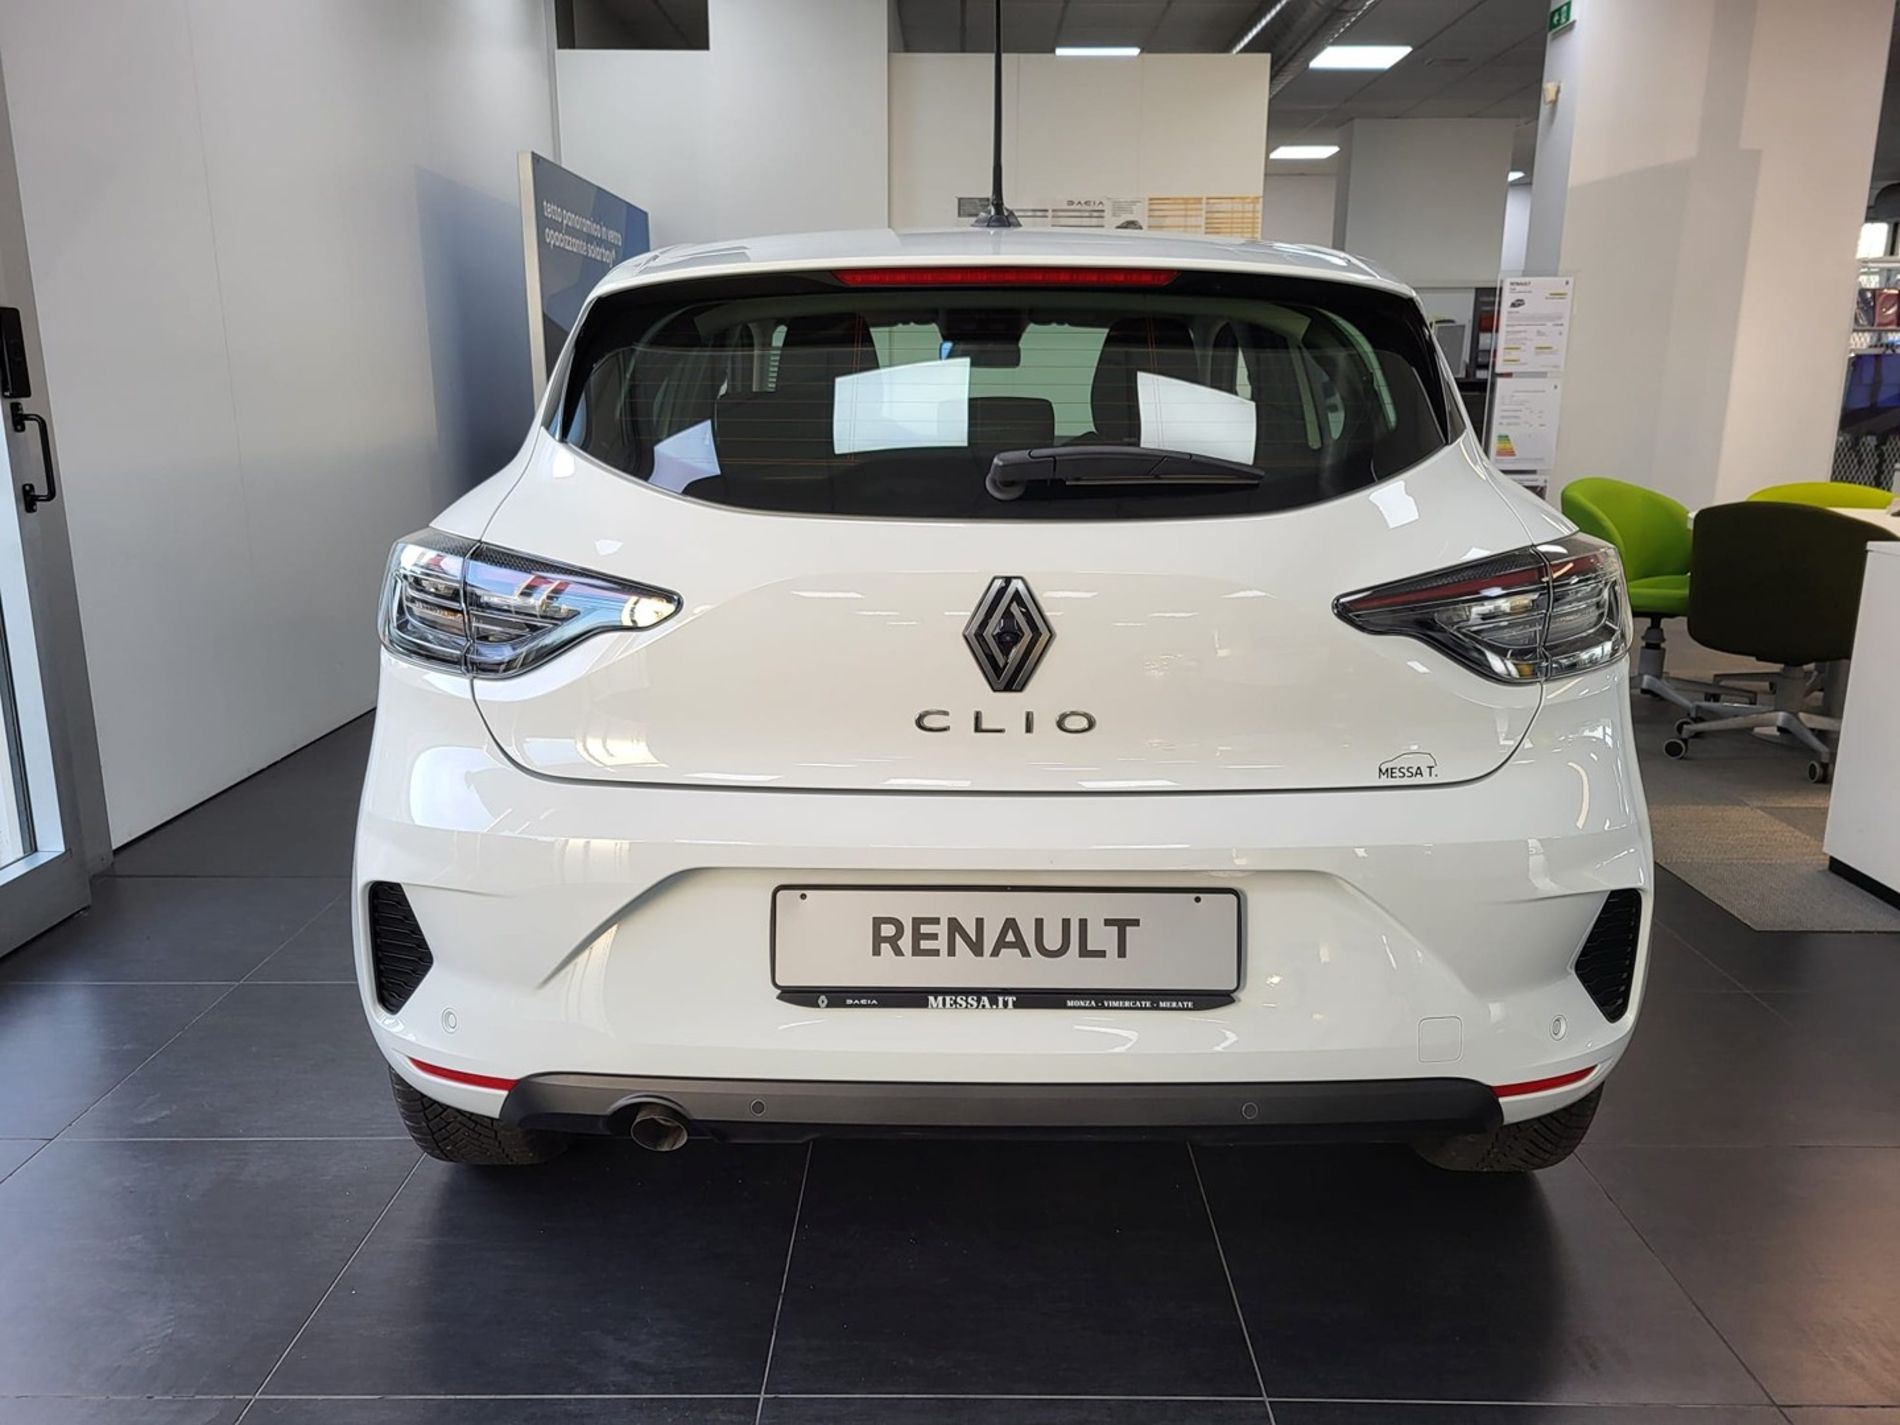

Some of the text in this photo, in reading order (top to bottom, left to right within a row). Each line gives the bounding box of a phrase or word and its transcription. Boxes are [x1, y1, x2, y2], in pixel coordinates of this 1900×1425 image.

[1066, 199, 1105, 208] DACIA
[915, 709, 1097, 735] CLIO
[1378, 765, 1438, 779] MESSA T.
[871, 916, 1140, 959] RENAULT
[927, 995, 1017, 1009] MESSA.IT
[1103, 1000, 1152, 1008] VIMERCATE
[1159, 1001, 1194, 1009] MERATE
